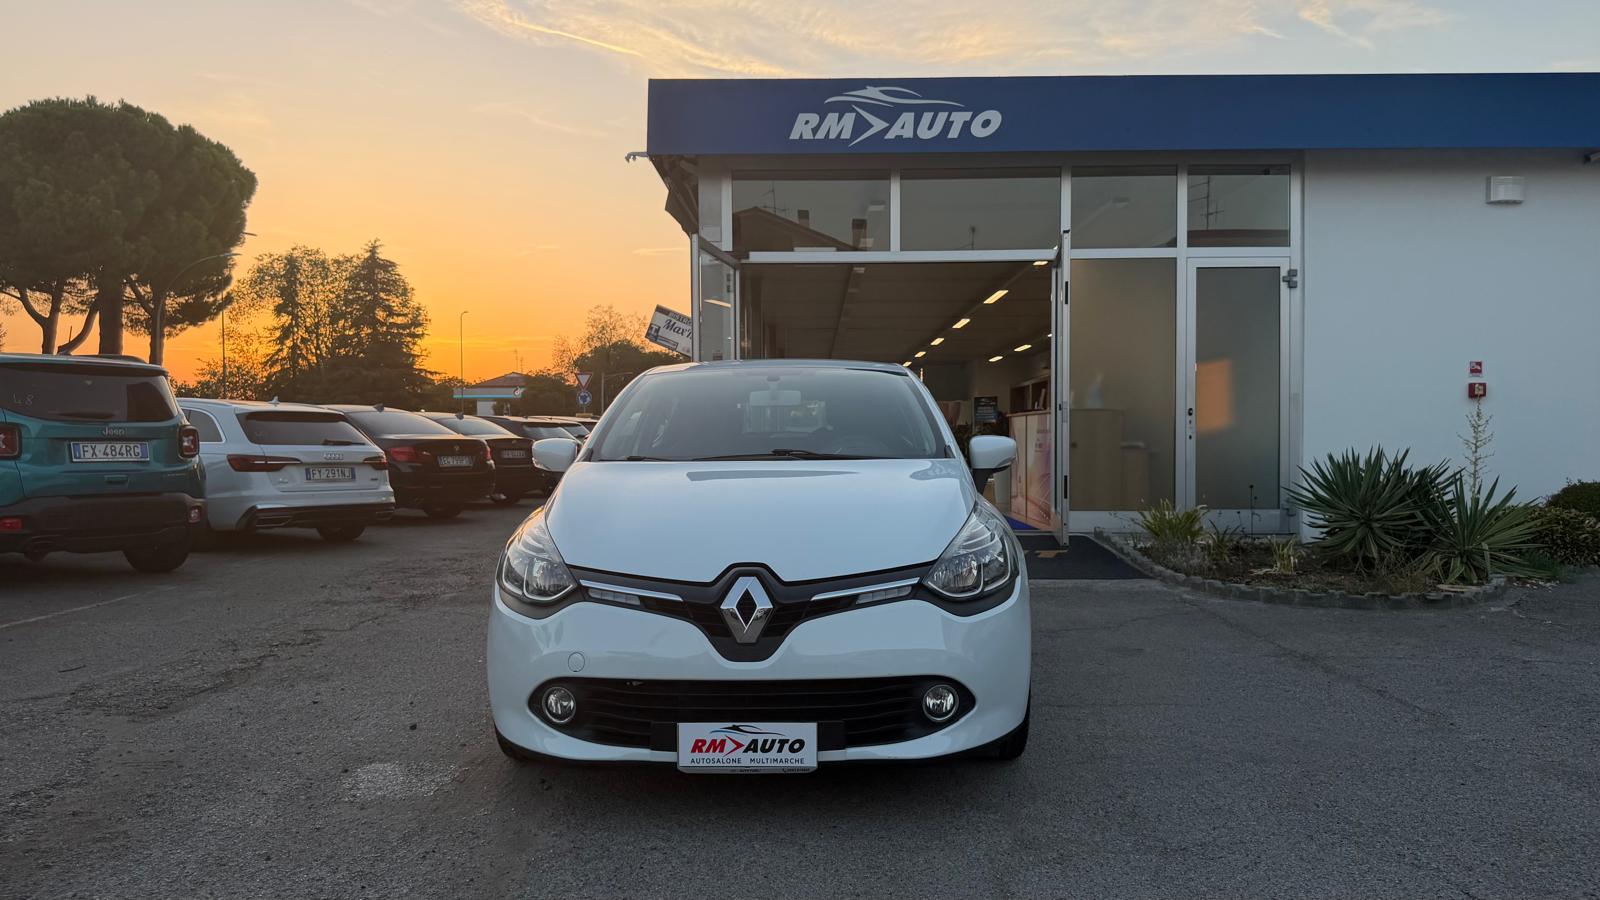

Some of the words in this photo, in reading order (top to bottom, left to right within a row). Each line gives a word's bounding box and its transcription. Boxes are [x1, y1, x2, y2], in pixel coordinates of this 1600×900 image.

[789, 112, 857, 140] RM
[884, 110, 1003, 140] AUTO
[102, 426, 126, 437] Jeep
[81, 444, 98, 458] FX
[102, 444, 140, 458] 484RG
[690, 738, 728, 754] RM
[742, 738, 806, 754] AUTO
[690, 757, 742, 765] AUTOSALONE
[749, 757, 805, 765] MULTIMARCHE
